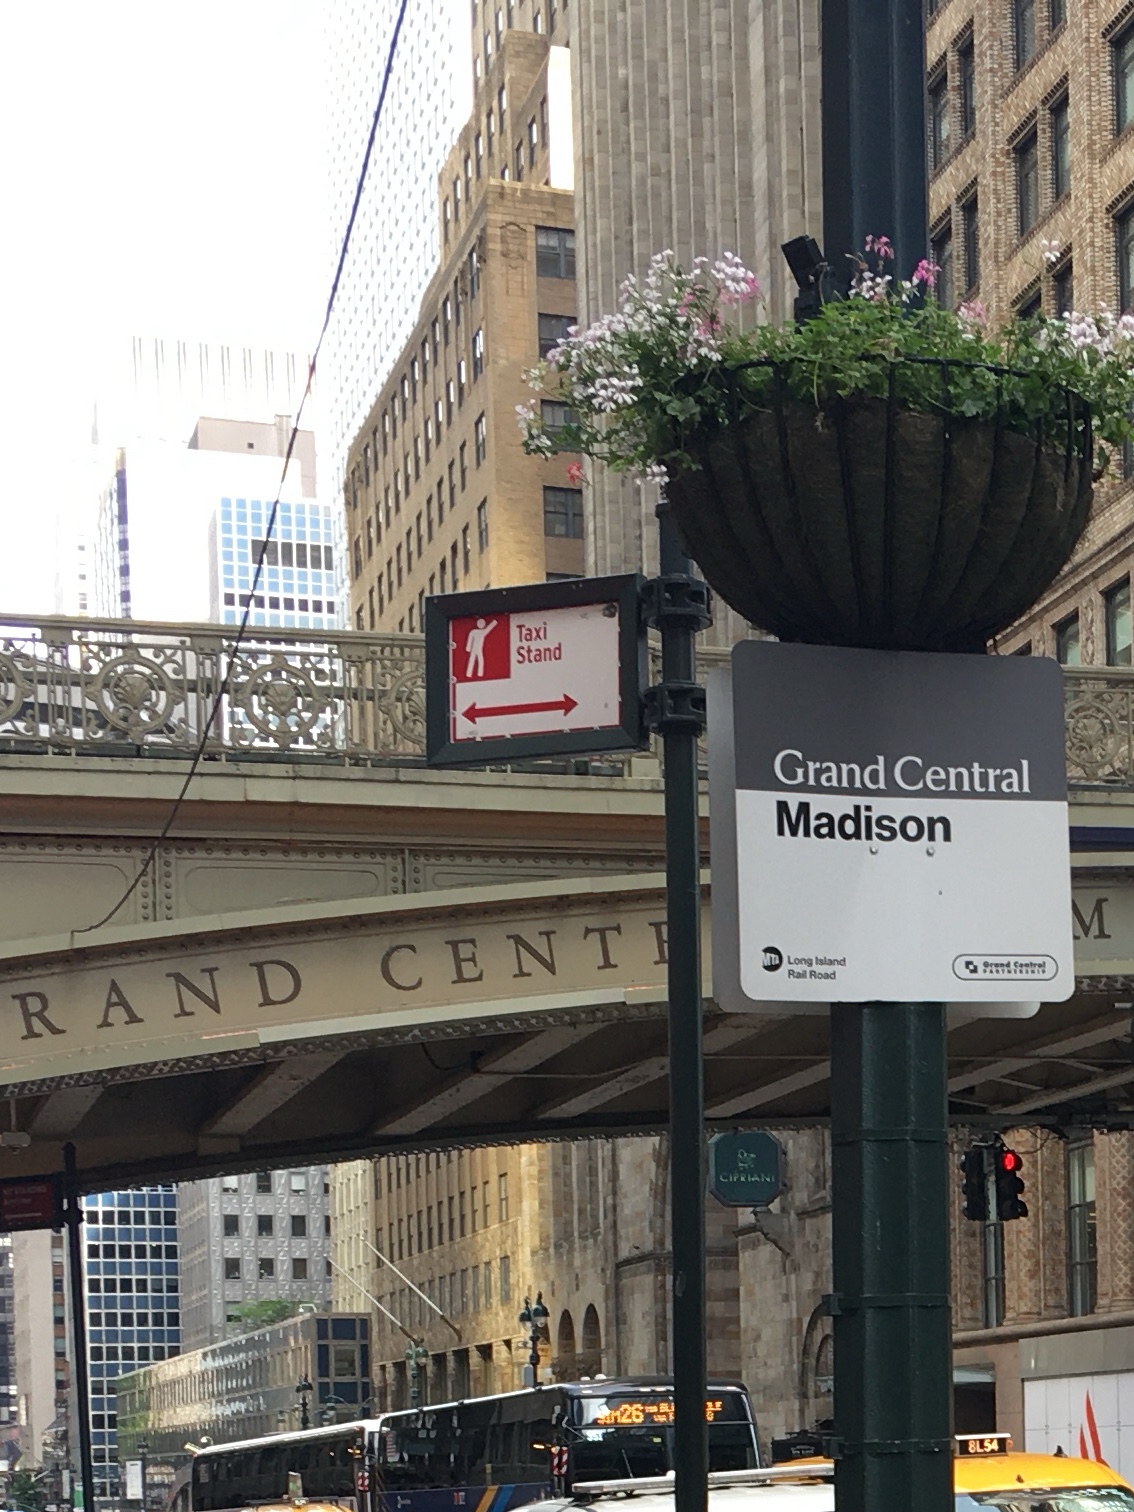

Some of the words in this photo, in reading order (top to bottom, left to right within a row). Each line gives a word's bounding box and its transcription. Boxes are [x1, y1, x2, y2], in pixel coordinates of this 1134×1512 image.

[516, 621, 547, 642] Taxi
[516, 642, 562, 664] Stand
[774, 749, 887, 790] Grand
[893, 755, 1031, 793] Central
[775, 800, 952, 843] Madison
[787, 955, 813, 967] Long
[815, 956, 846, 966] Island
[982, 960, 1011, 968] Grand
[1013, 960, 1046, 968] Central
[787, 968, 807, 980] Rail
[809, 969, 836, 980] Road
[10, 958, 303, 1041] RAND
[968, 1438, 999, 1453] 8L54
